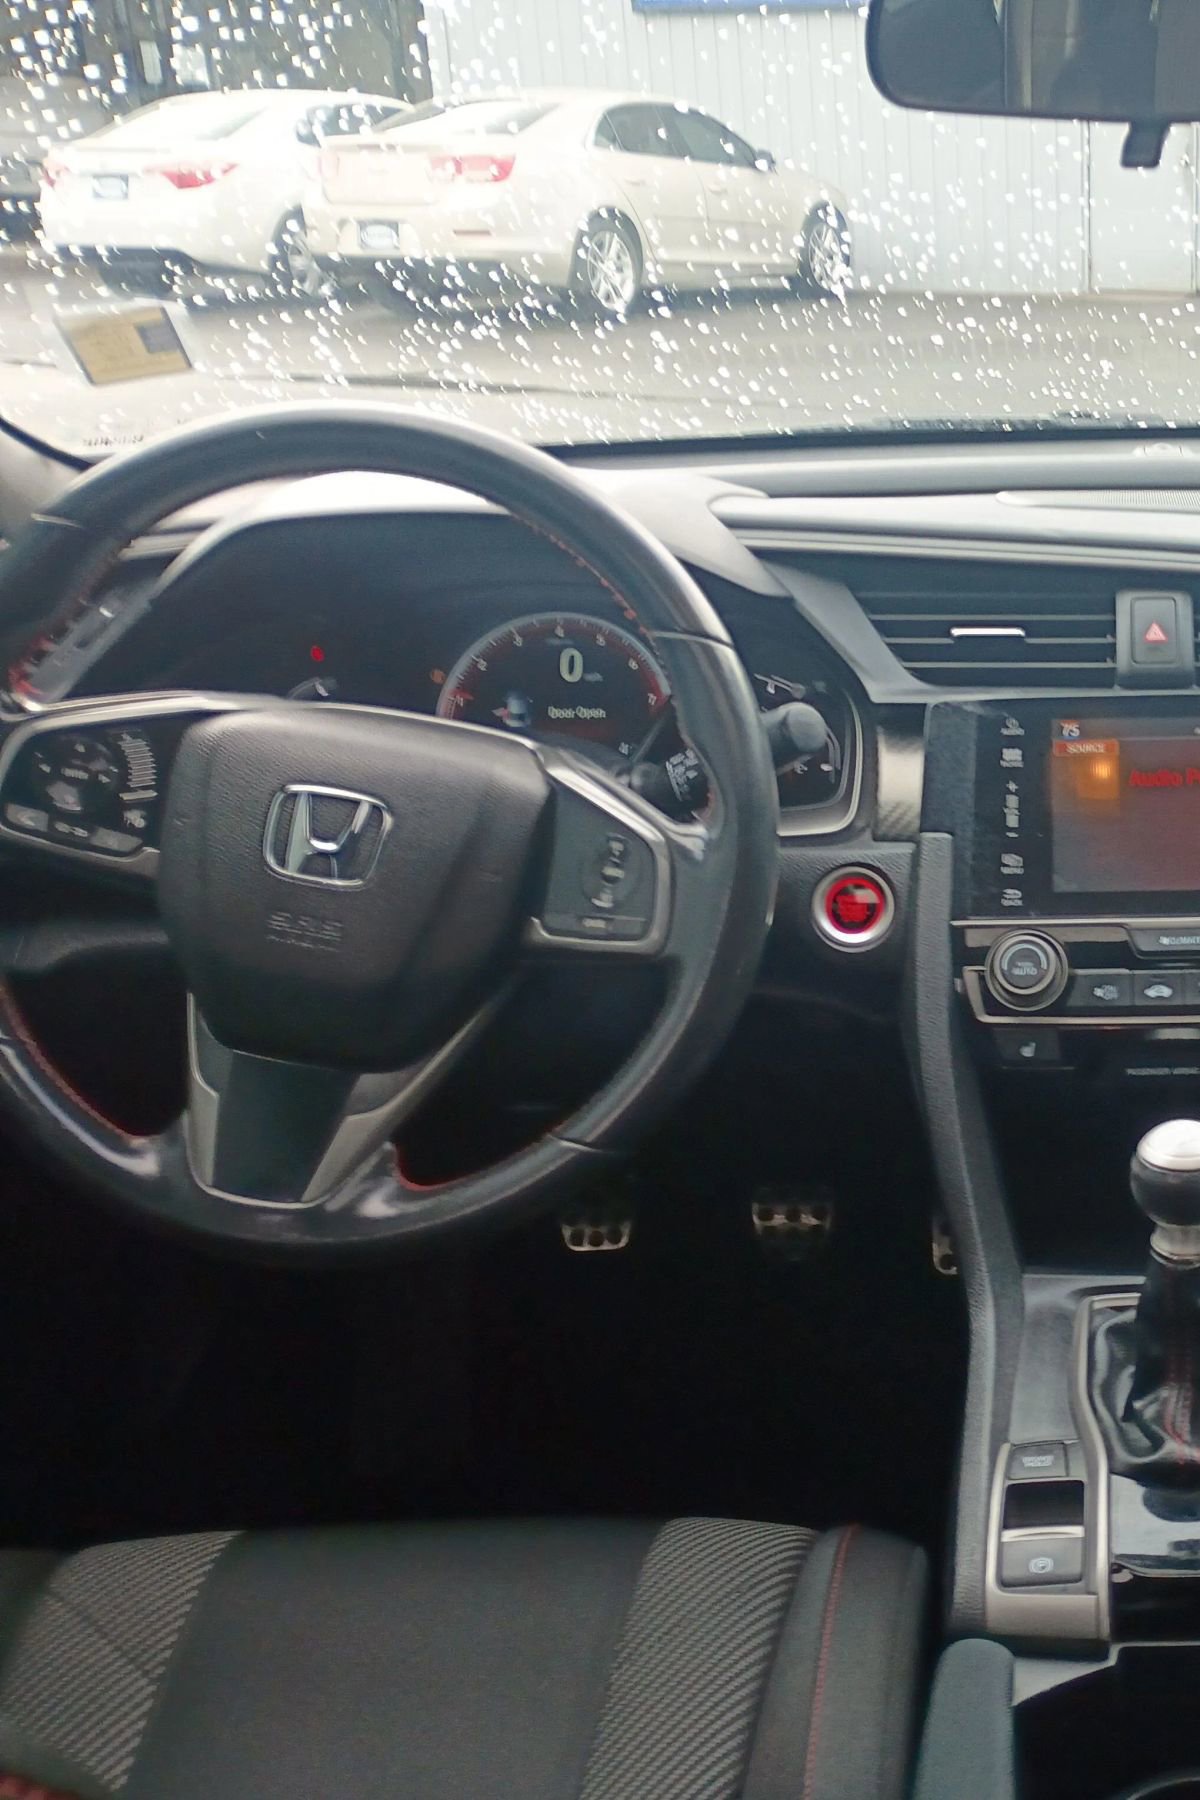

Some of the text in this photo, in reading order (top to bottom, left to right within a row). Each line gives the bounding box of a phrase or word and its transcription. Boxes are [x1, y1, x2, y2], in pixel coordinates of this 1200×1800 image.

[560, 647, 583, 682] 0
[548, 705, 606, 720] Door Open
[1129, 769, 1182, 786] Audio
